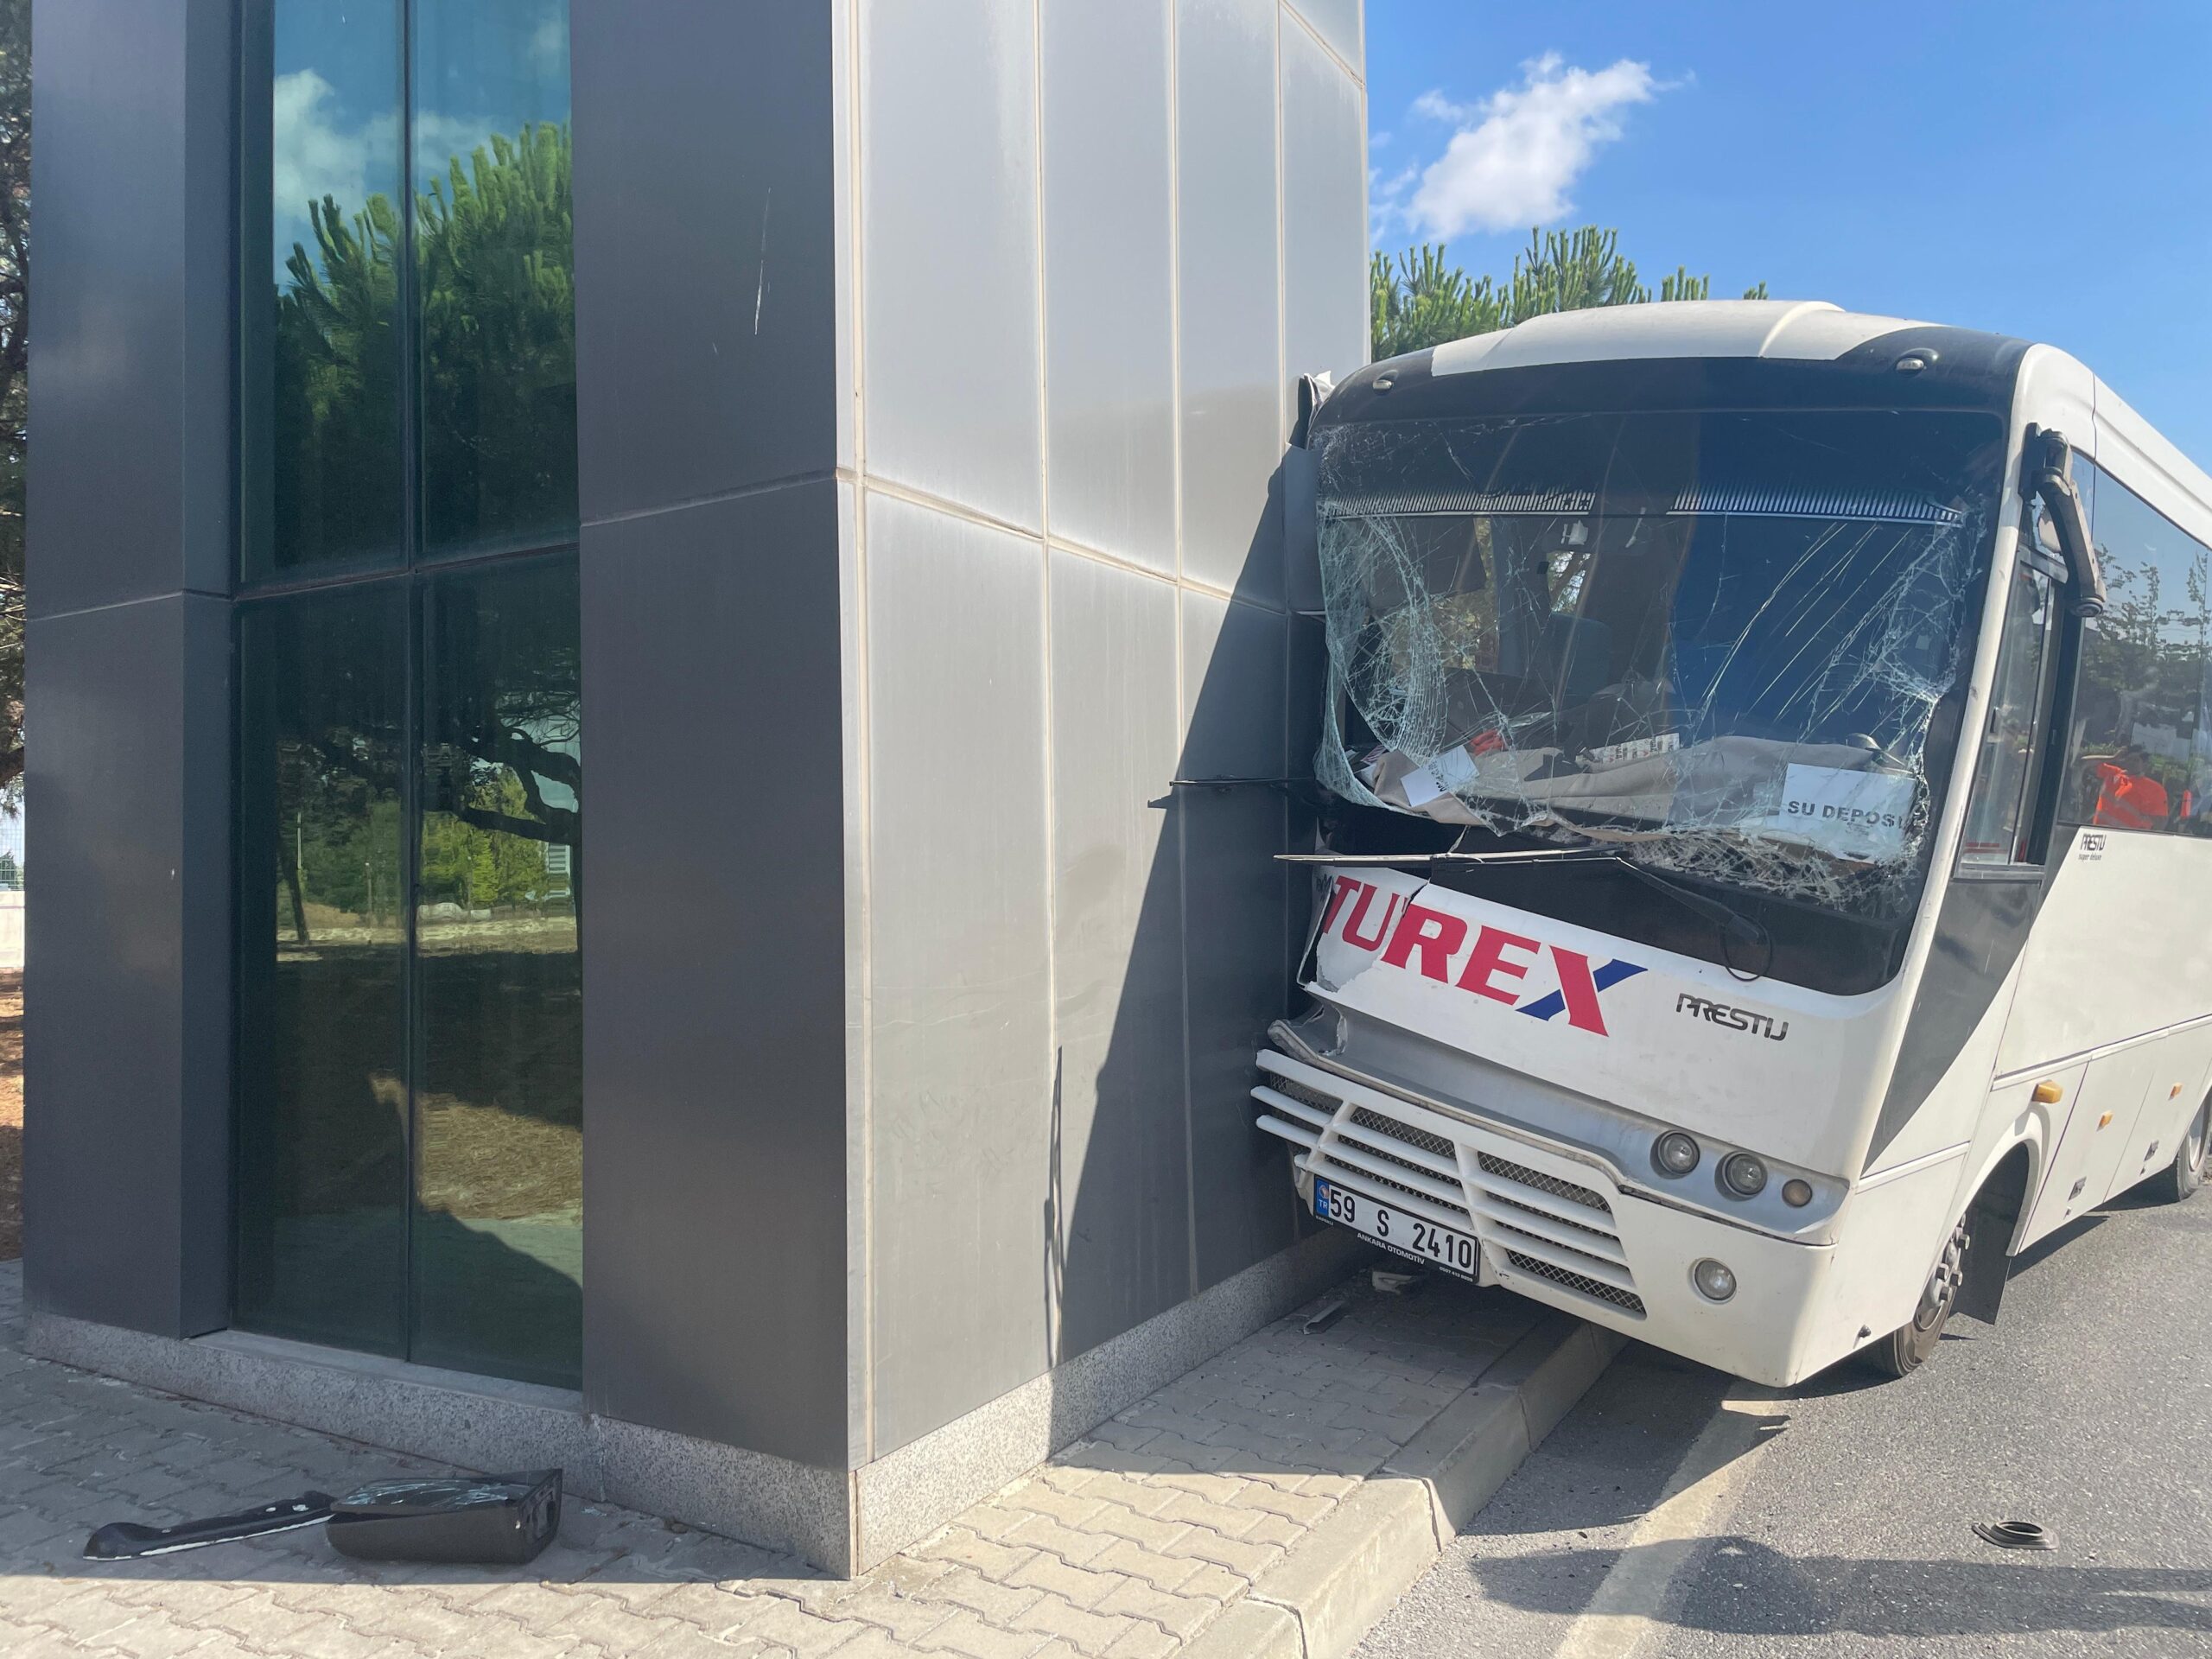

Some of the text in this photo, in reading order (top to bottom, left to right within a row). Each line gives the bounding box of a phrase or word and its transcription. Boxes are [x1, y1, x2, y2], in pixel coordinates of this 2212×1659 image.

[1787, 800, 1816, 817] SU
[1322, 874, 1649, 1038] TUREX
[1318, 1188, 1473, 1269] TR 59 S 2410
[1357, 1232, 1387, 1250] ANKARA
